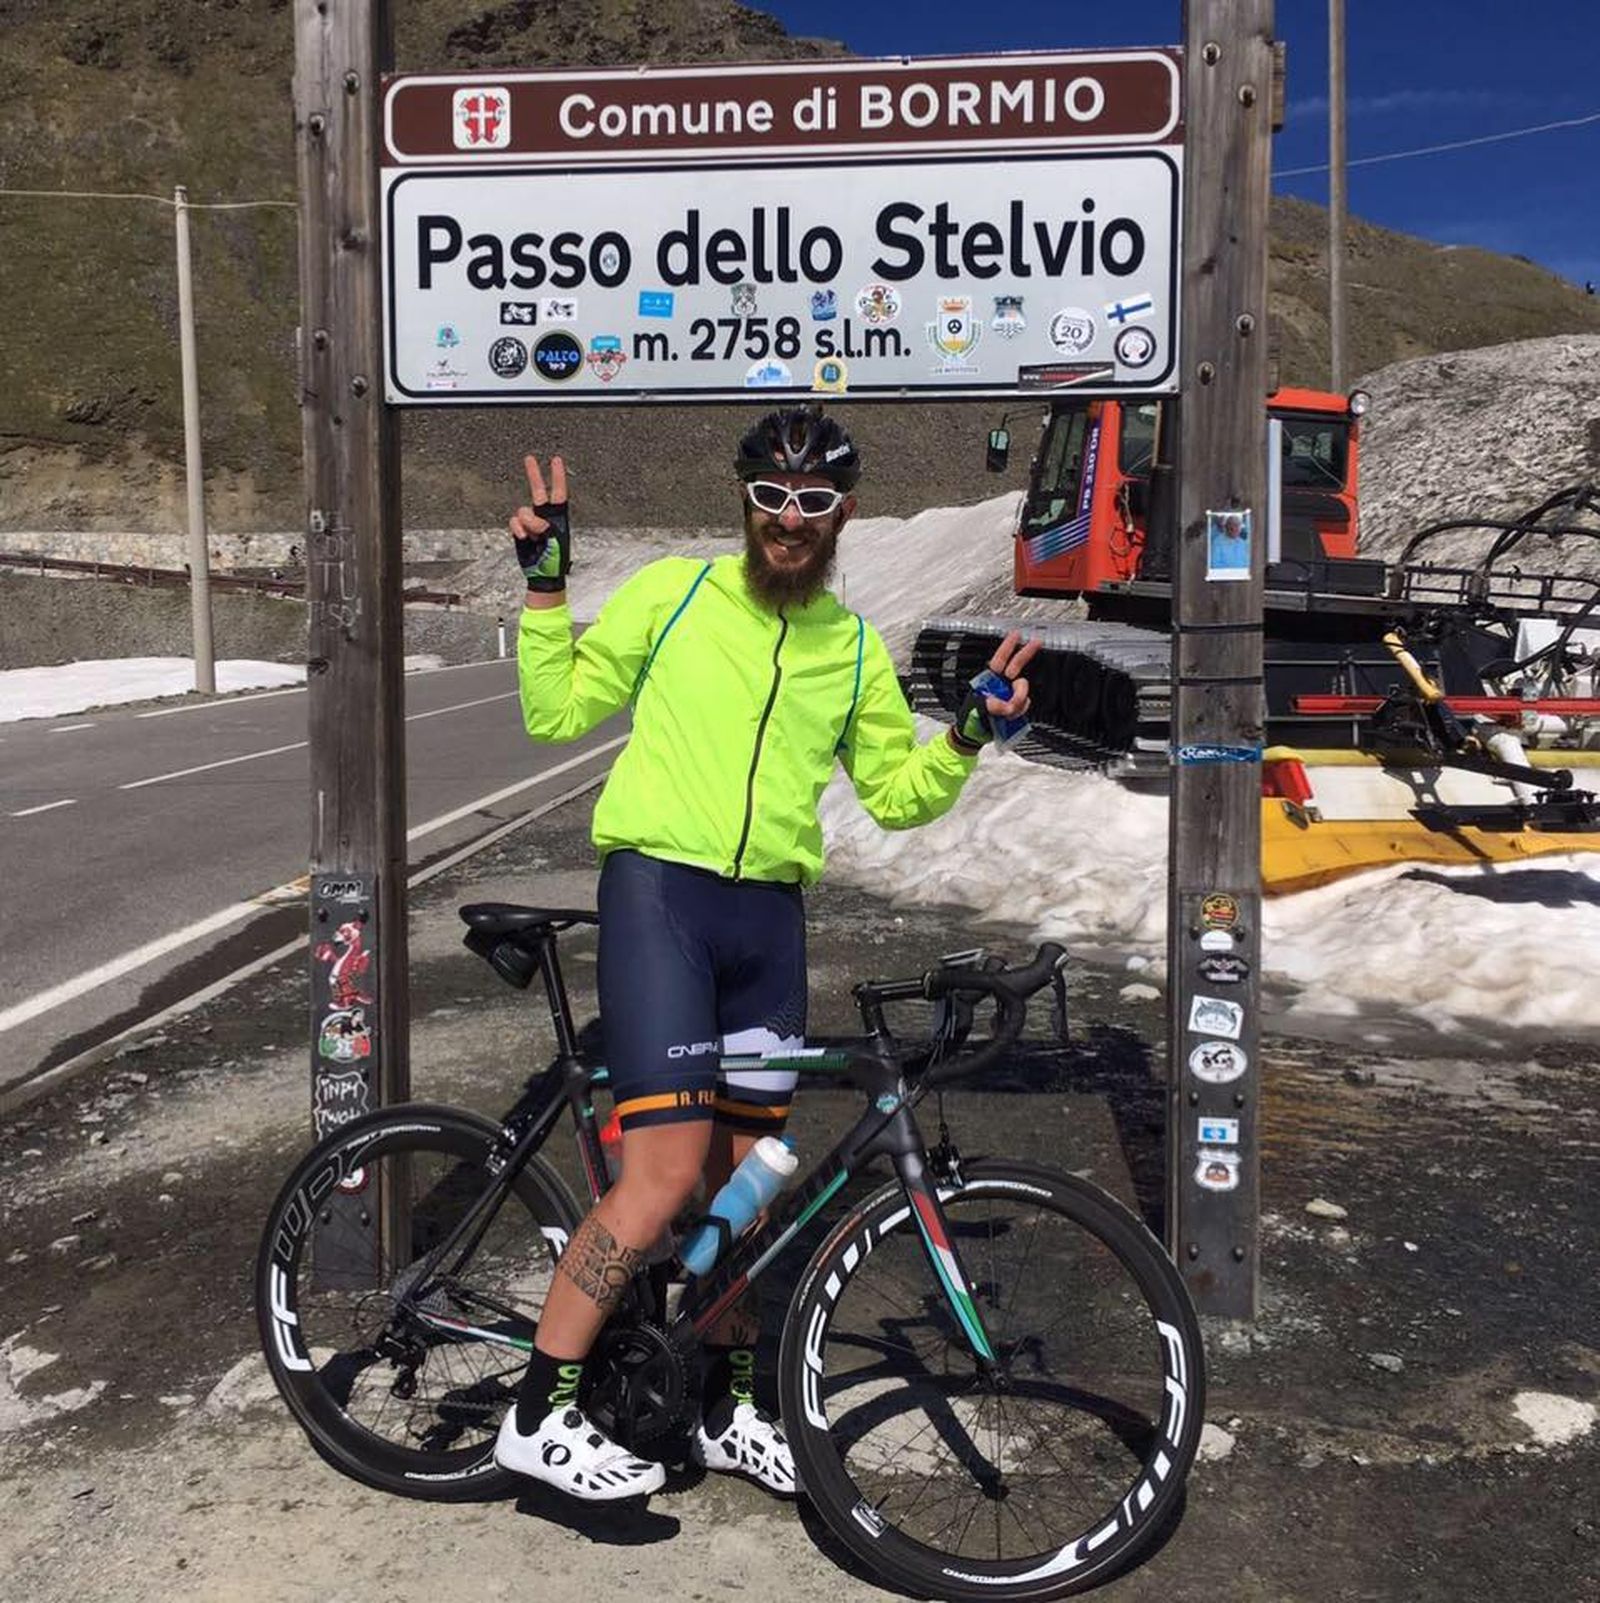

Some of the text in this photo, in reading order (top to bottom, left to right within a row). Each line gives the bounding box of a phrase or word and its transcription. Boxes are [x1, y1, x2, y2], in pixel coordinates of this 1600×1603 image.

[559, 76, 1105, 137] Comune di BORMIO
[418, 198, 1145, 290] Passo dello Stelvio
[633, 316, 911, 361] m. 2758 s.l.m.
[1061, 325, 1082, 340] 20
